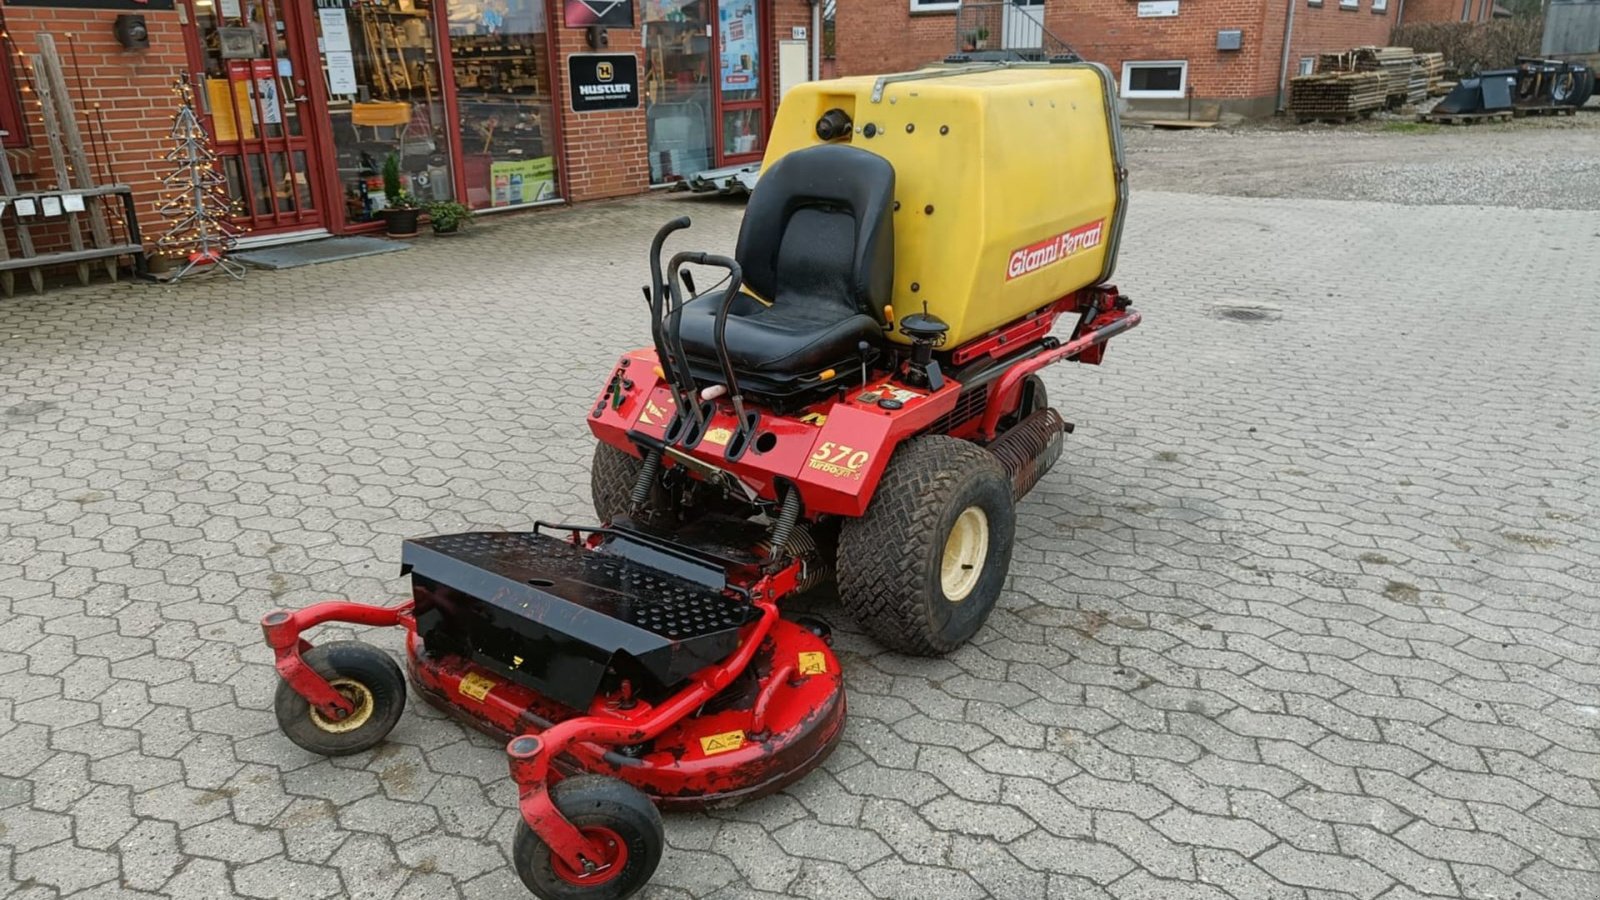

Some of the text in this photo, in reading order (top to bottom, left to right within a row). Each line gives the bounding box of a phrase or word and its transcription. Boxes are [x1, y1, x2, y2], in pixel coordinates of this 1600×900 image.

[579, 84, 631, 95] HUSTLER
[1009, 222, 1102, 277] Gianni Ferrari
[812, 441, 869, 469] 570
